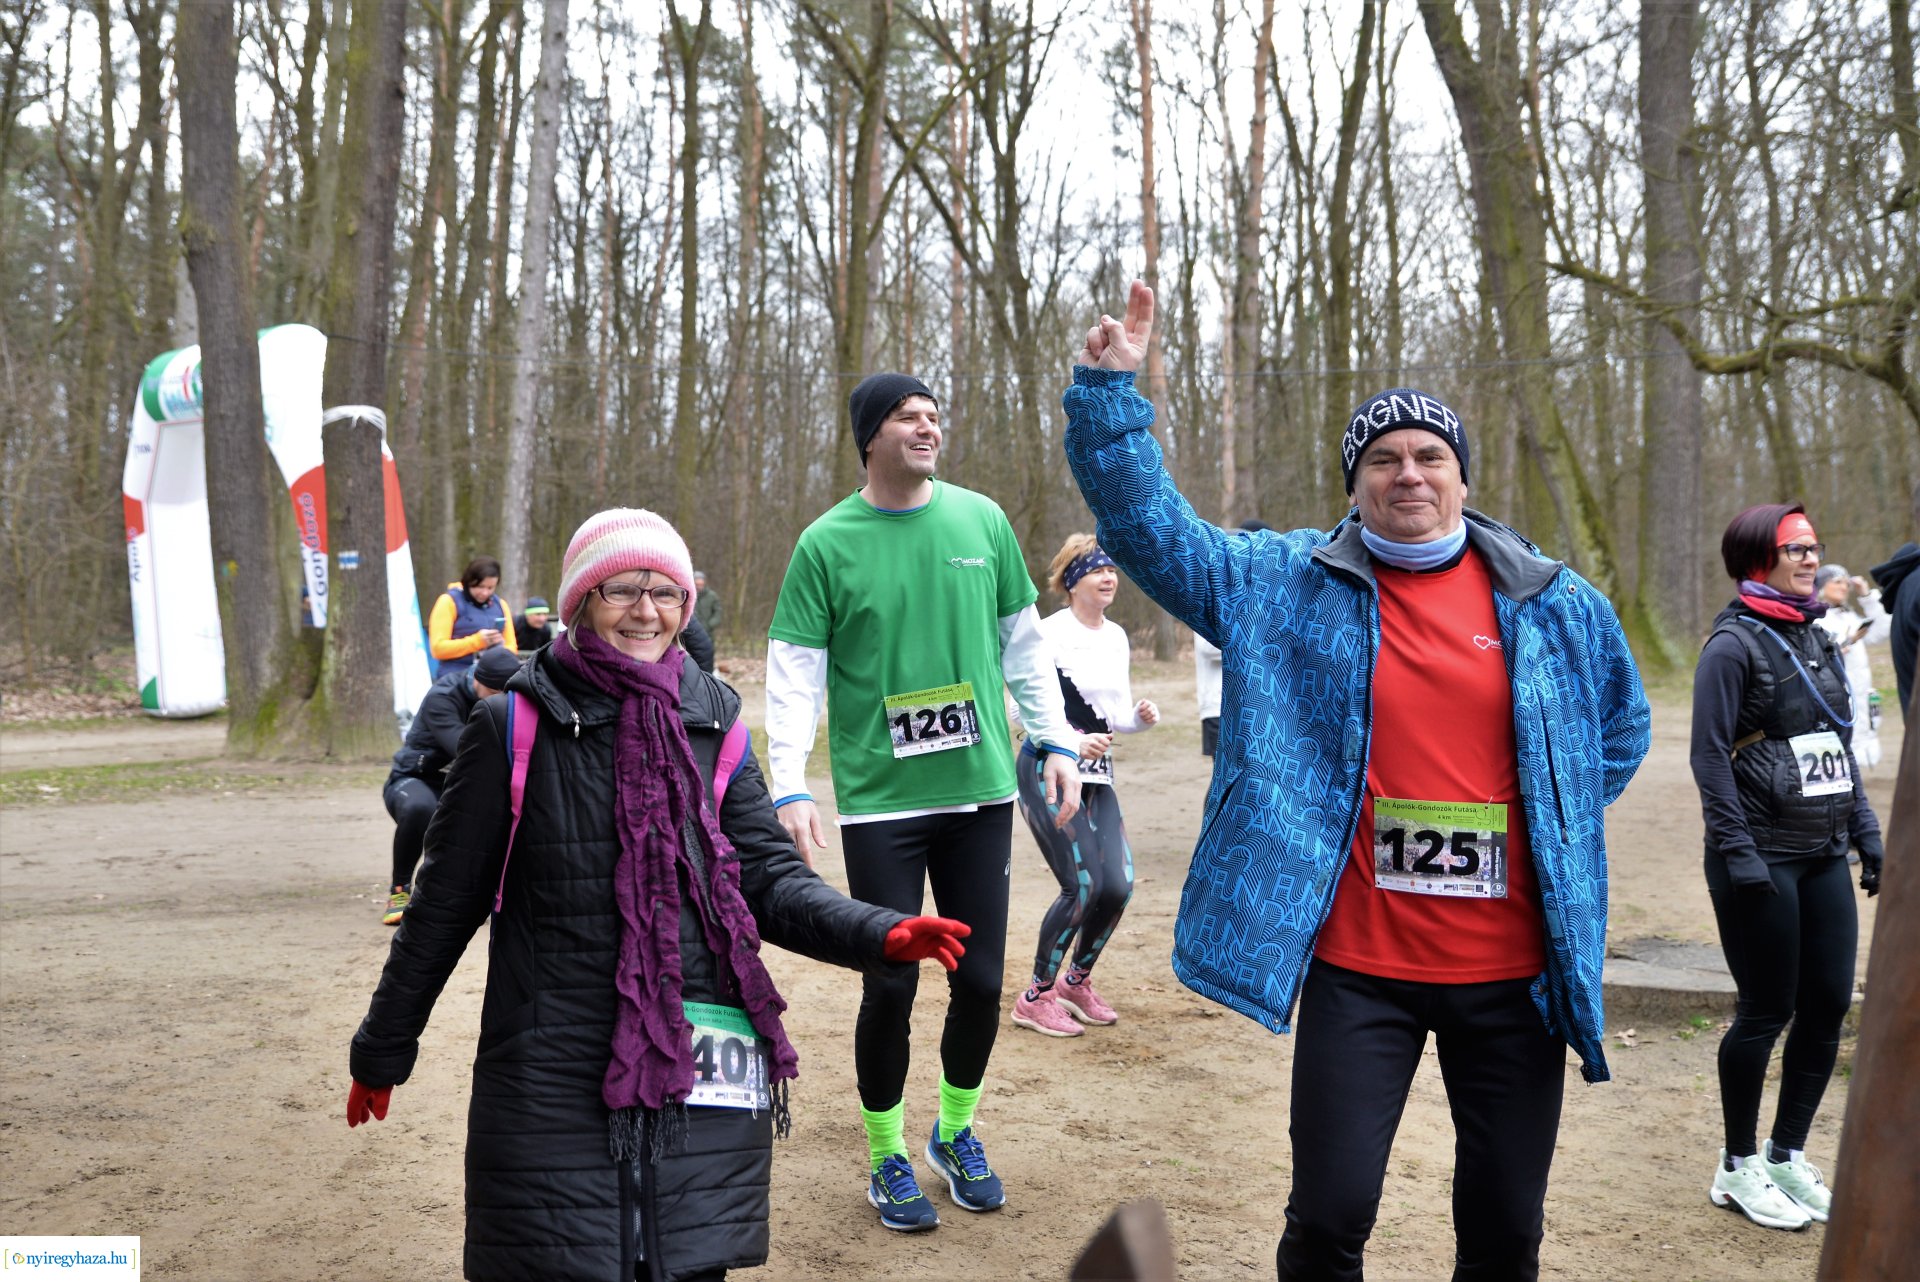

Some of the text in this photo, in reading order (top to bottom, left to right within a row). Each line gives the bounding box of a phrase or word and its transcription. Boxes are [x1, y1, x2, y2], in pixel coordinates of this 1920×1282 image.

[1342, 393, 1460, 471] BOGNER
[894, 703, 962, 742] 126
[1802, 749, 1846, 782] 201
[1392, 801, 1453, 812] Ápolók-Gondozók
[1453, 806, 1477, 814] Futása
[1380, 827, 1480, 876] 125
